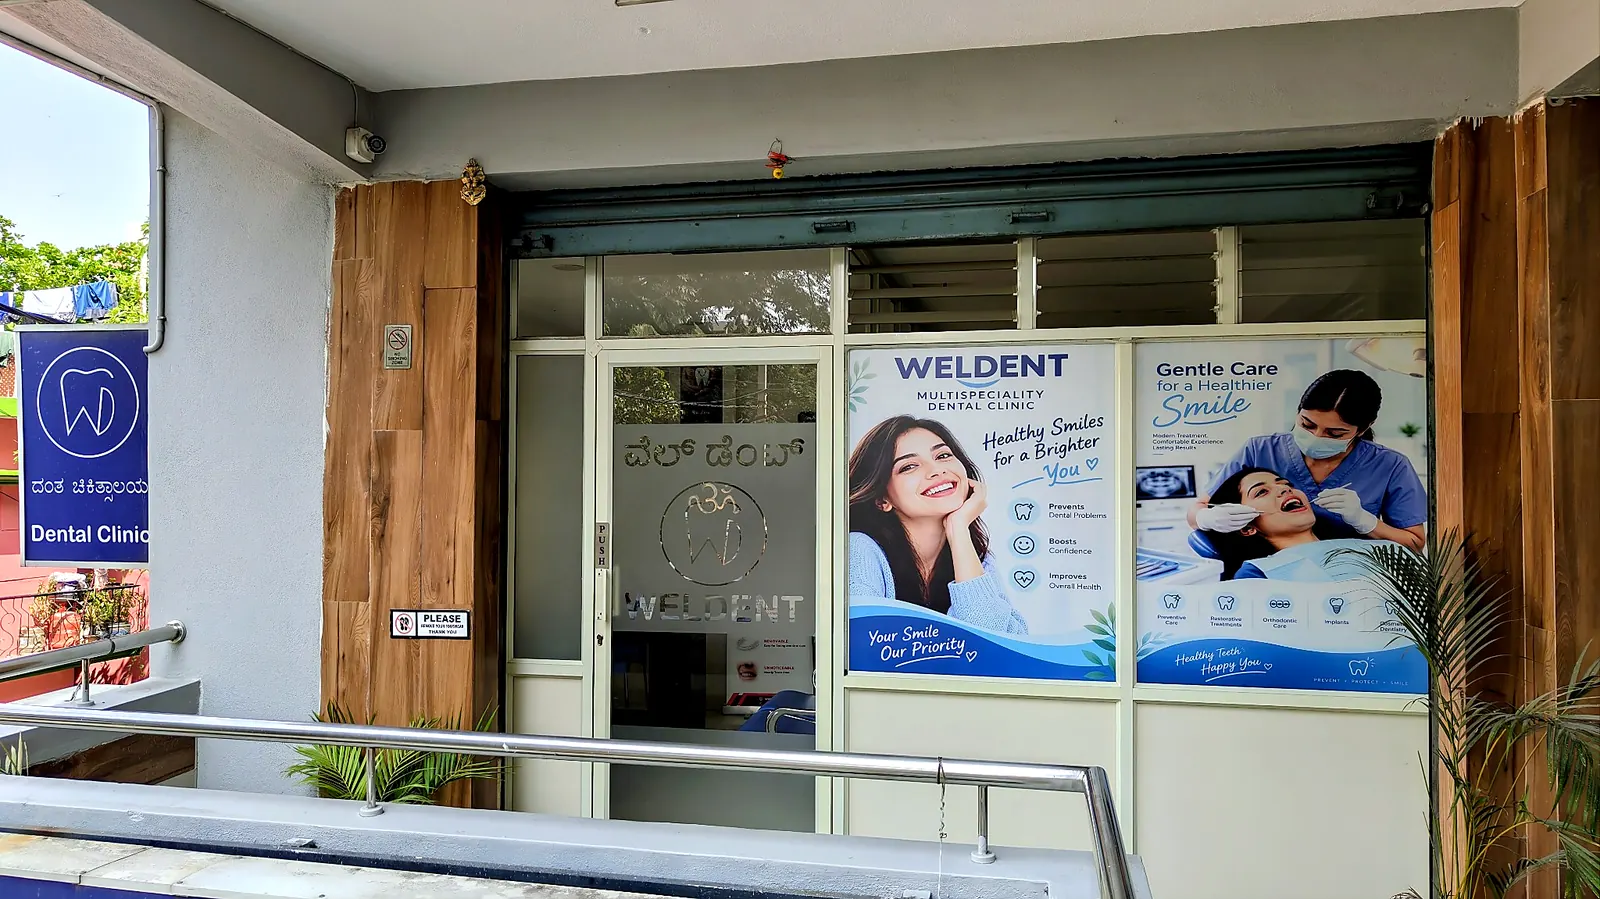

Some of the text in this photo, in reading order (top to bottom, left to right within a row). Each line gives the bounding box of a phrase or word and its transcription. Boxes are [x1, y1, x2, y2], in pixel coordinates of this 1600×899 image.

[894, 354, 1069, 380] WELDENT
[1156, 362, 1278, 377] Gentle Care
[917, 389, 1045, 400] MULTISPECIALITY
[1157, 379, 1273, 391] for a Healthier
[928, 401, 1035, 411] DENTAL CLINIC
[1152, 391, 1252, 427] Smile
[982, 413, 1104, 451] Healthy Smiles
[993, 436, 1101, 470] for a Brighter
[1043, 461, 1081, 487] You
[31, 478, 64, 494] ದಂತ
[31, 525, 149, 543] Dental Clinic
[598, 525, 606, 566] PUSH
[1048, 547, 1092, 555] Confidence
[1049, 572, 1087, 580] Improves
[624, 592, 804, 623] WELDENT
[423, 614, 461, 623] PLEASE
[868, 624, 939, 647] Your Smile
[880, 637, 966, 661] Our Priority
[1175, 646, 1242, 666] Healthy Teeth
[1201, 657, 1261, 676] Happy You
